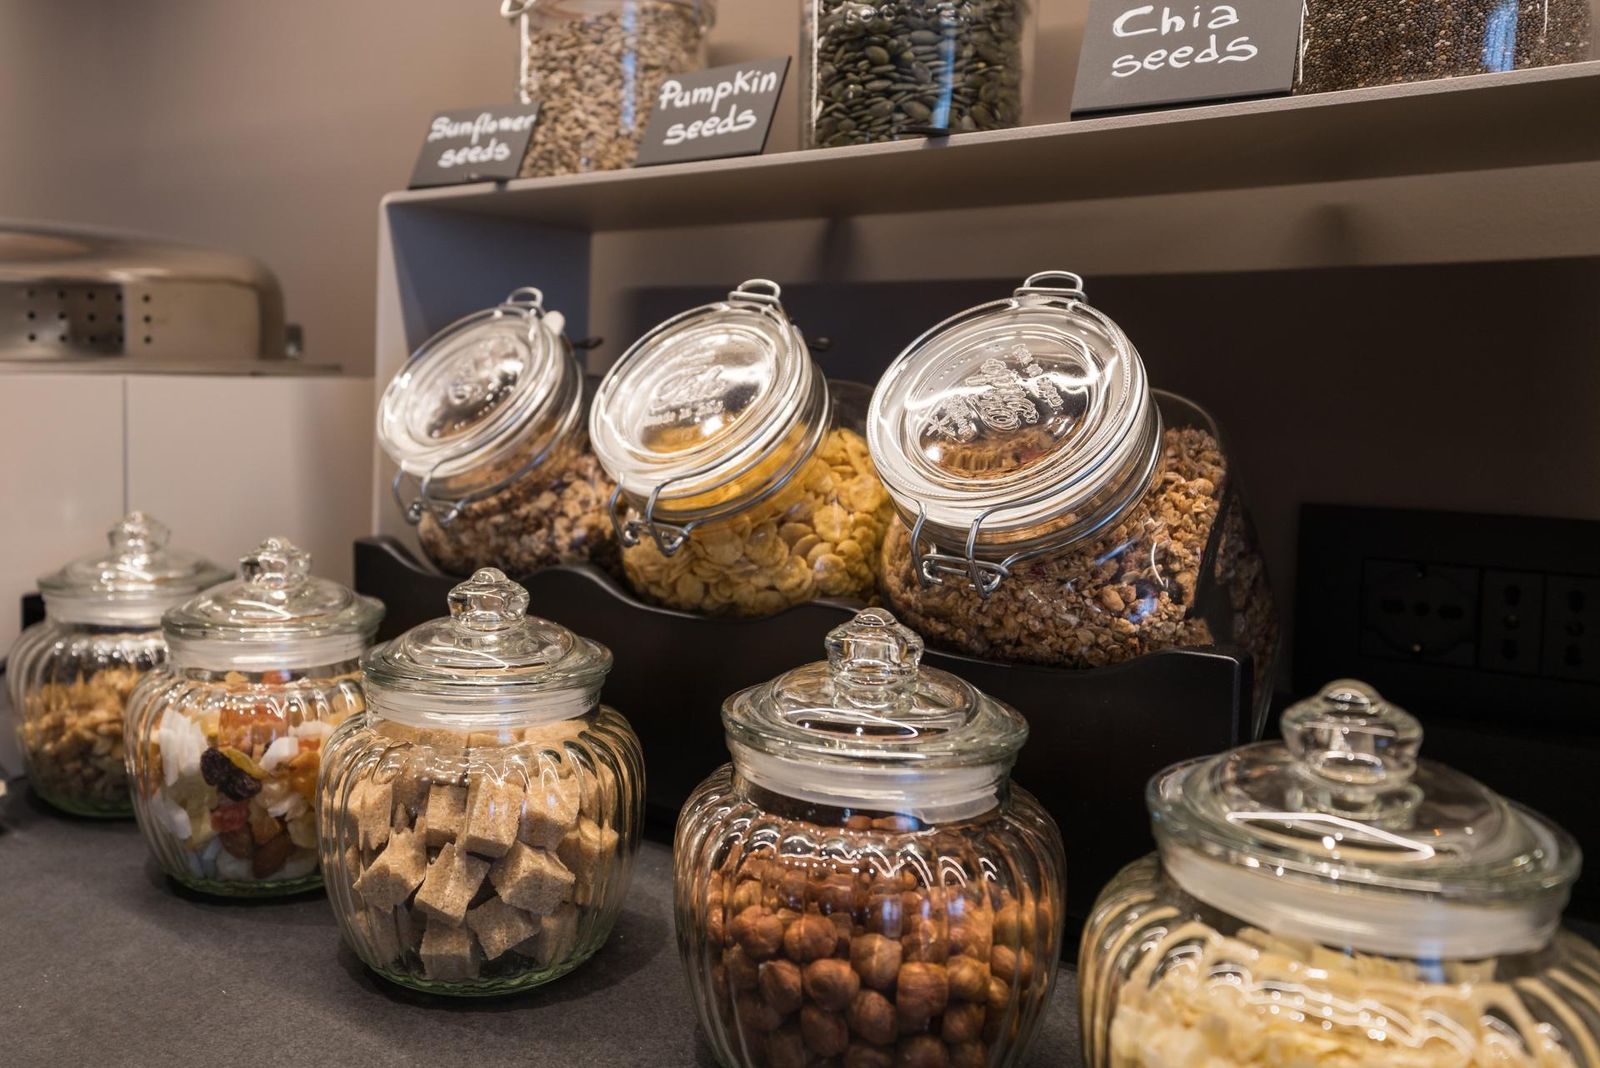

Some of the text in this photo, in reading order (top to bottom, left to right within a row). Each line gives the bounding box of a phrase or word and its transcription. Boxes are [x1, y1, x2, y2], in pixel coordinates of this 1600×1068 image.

[1112, 5, 1239, 37] Chia
[1111, 33, 1258, 78] seeds
[427, 112, 536, 145] Sunflower
[663, 103, 758, 146] seeds
[437, 137, 511, 168] seeds
